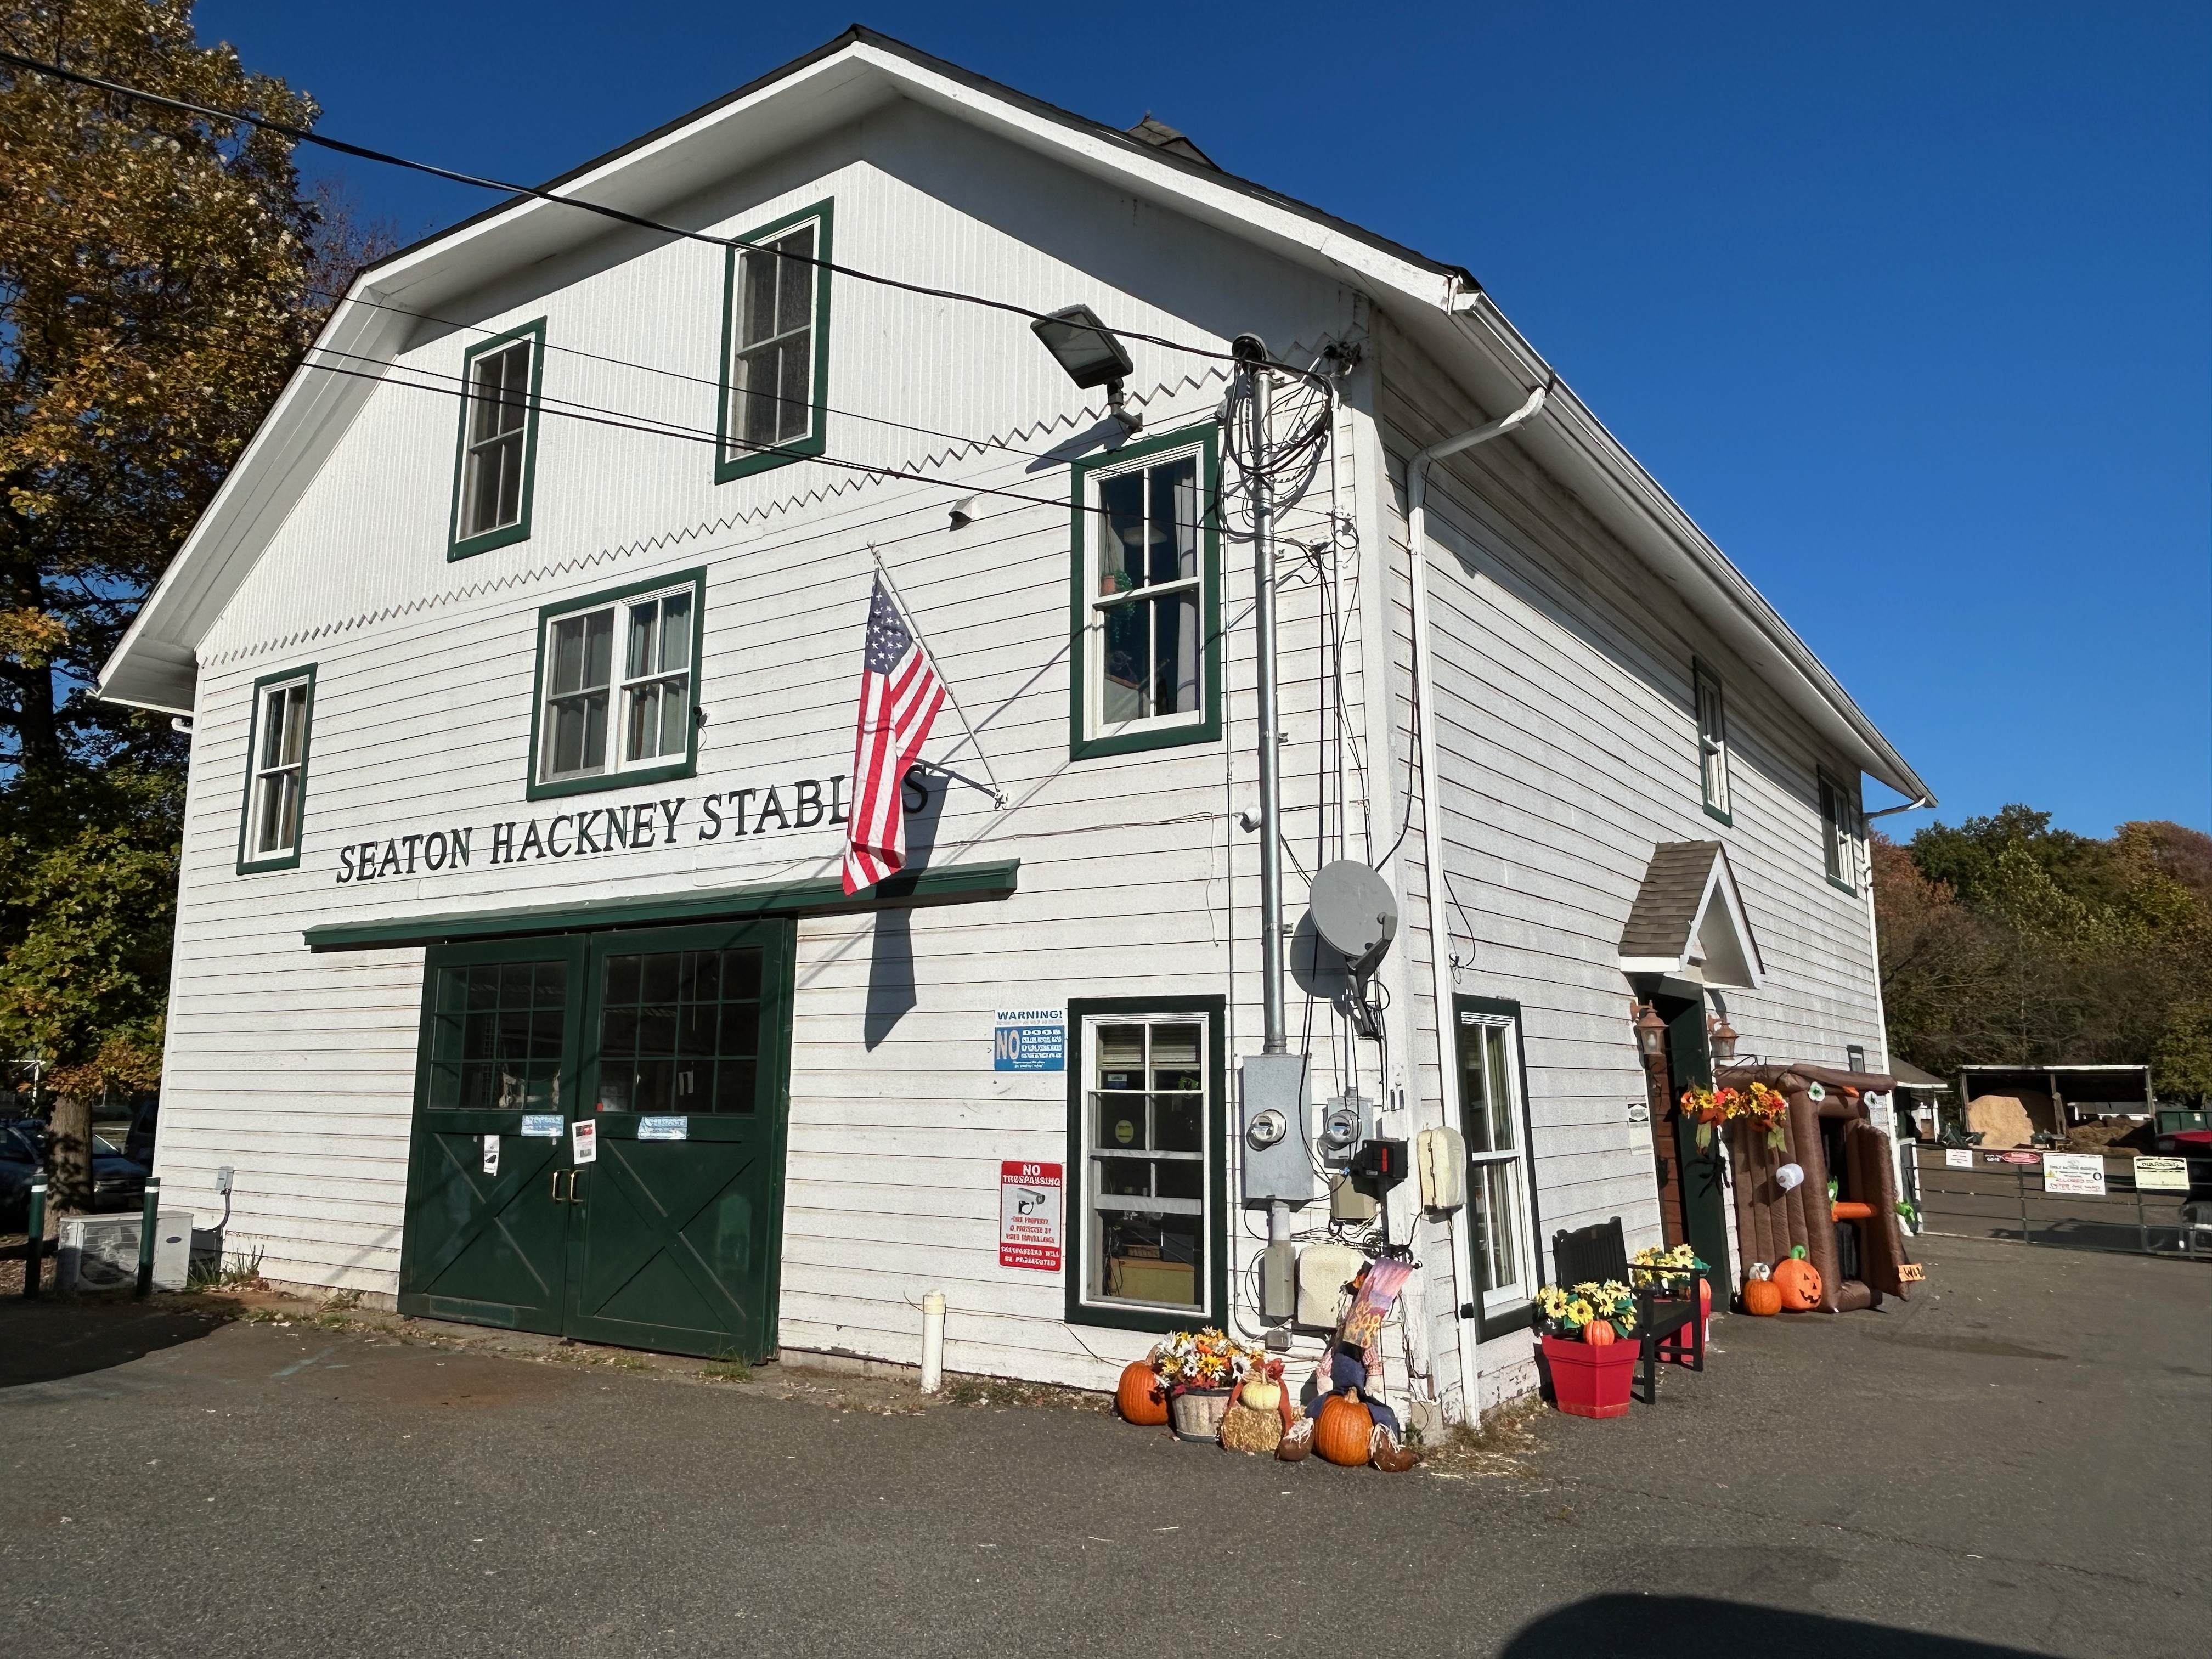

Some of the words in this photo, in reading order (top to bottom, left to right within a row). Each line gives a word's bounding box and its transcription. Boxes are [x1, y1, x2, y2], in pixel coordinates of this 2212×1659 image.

[337, 827, 472, 883] SEATON
[490, 798, 687, 864] HACKNEY
[699, 764, 929, 840] STABLS
[997, 1010, 1062, 1020] WARNING!
[996, 1030, 1020, 1059] NO
[1023, 1164, 1041, 1176] NO
[1003, 1175, 1060, 1186] TRESPASSING
